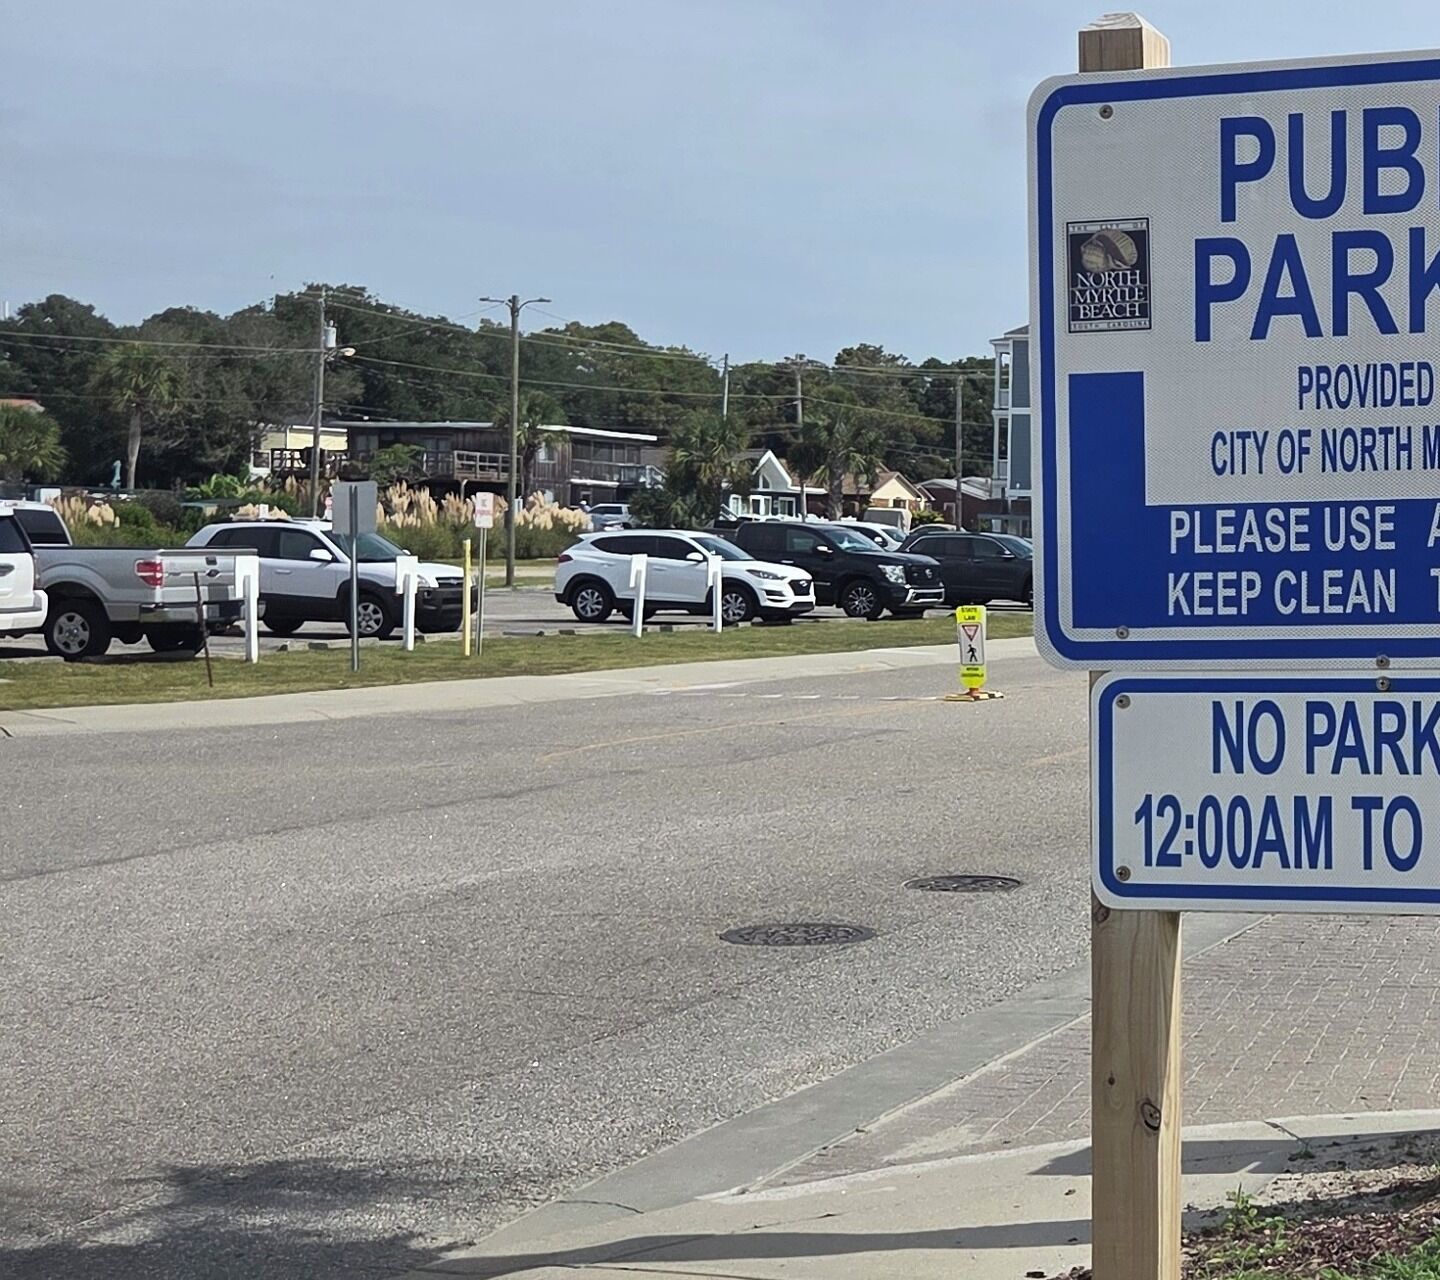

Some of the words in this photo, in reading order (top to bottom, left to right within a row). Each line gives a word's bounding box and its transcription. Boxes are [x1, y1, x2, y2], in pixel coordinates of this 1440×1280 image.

[1072, 287, 1145, 305] MYRTLE
[1076, 269, 1141, 289] NORTH
[1079, 302, 1141, 320] BEACH
[1298, 360, 1434, 411] PROVIDED
[1210, 428, 1270, 477] CITY
[1276, 426, 1312, 475] OF
[1320, 424, 1413, 473] NORTH
[1169, 506, 1311, 555] PLEASE
[1323, 505, 1397, 552] USE
[1167, 570, 1263, 617] KEEP
[1273, 568, 1397, 615] CLEAN
[1212, 699, 1286, 776] NO
[1134, 793, 1334, 870] 12:00AM
[1352, 795, 1423, 872] TO
